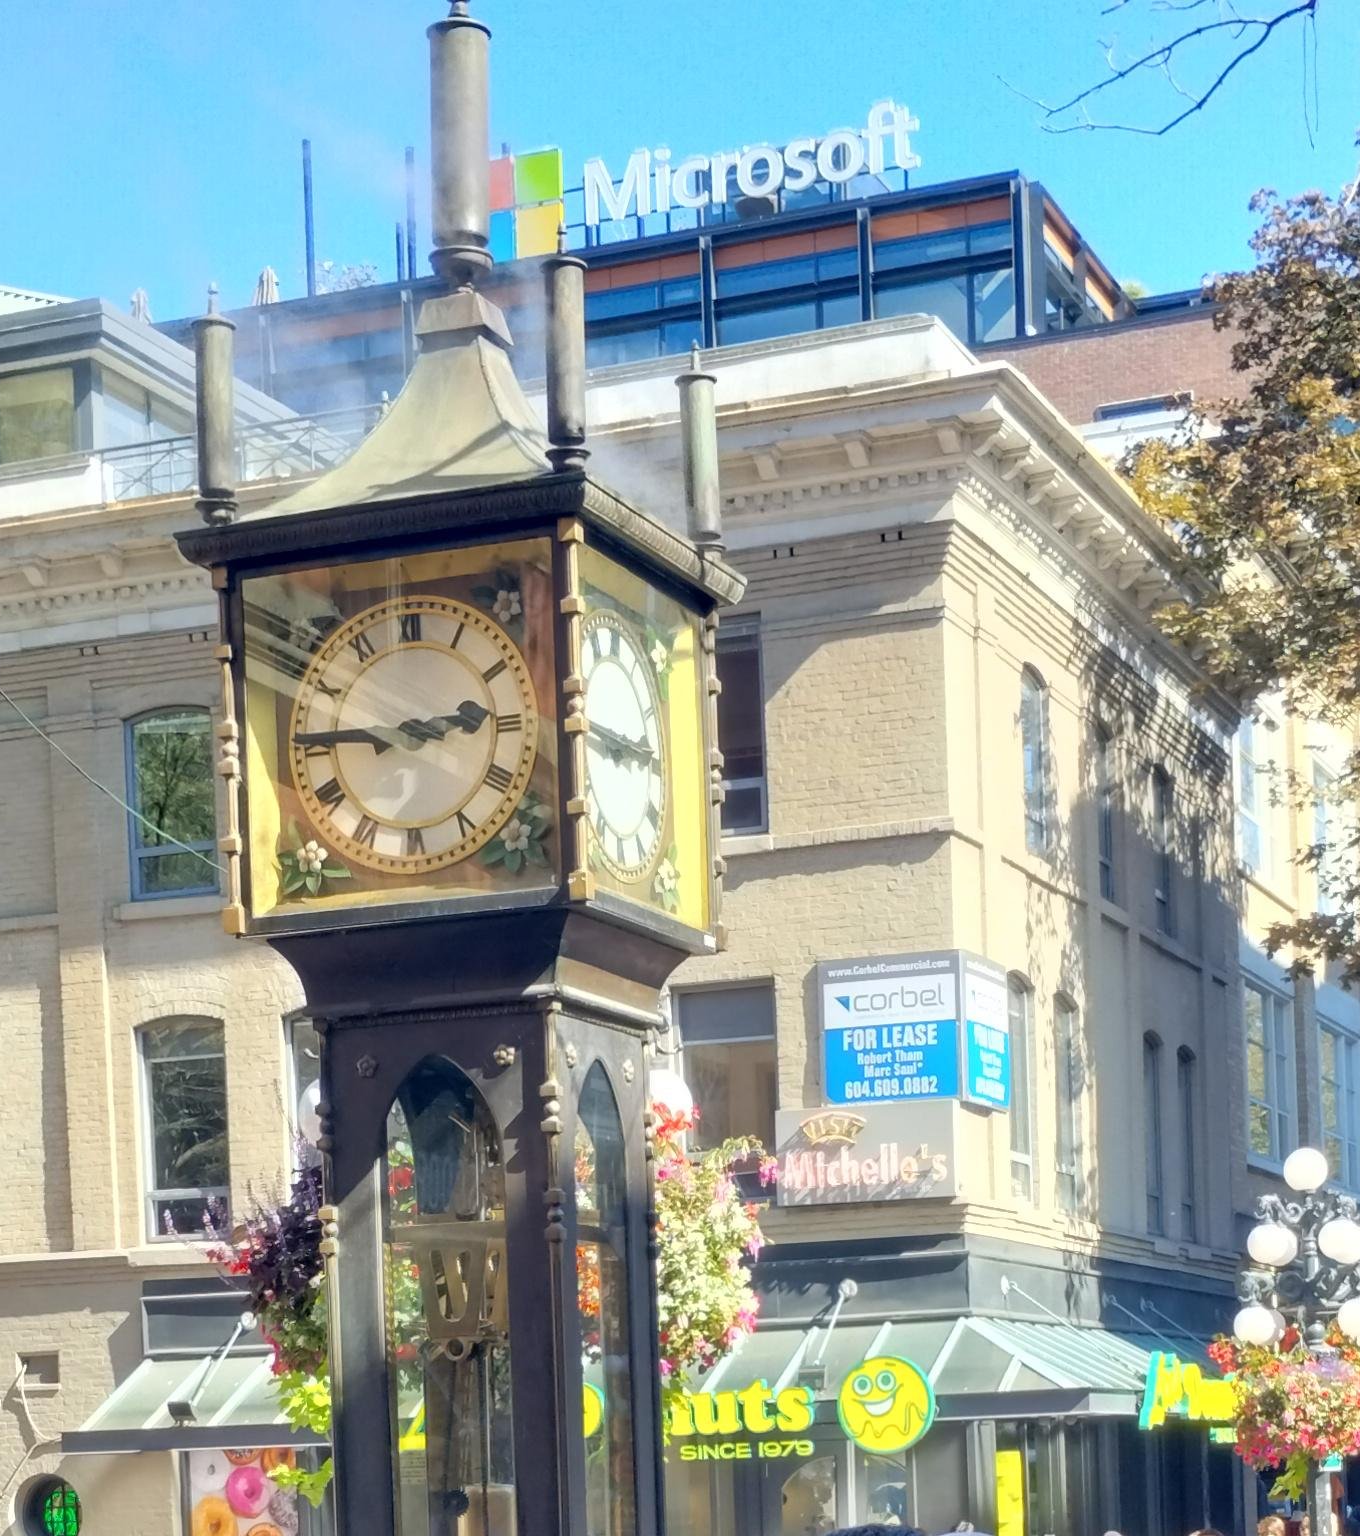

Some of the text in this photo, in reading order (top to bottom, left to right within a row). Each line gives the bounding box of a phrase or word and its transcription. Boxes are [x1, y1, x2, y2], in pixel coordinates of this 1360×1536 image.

[584, 98, 921, 227] Microsoft
[853, 982, 945, 1012] corbel
[842, 1023, 938, 1051] FOR LEASE
[679, 1439, 814, 1461] SINCE 1979
